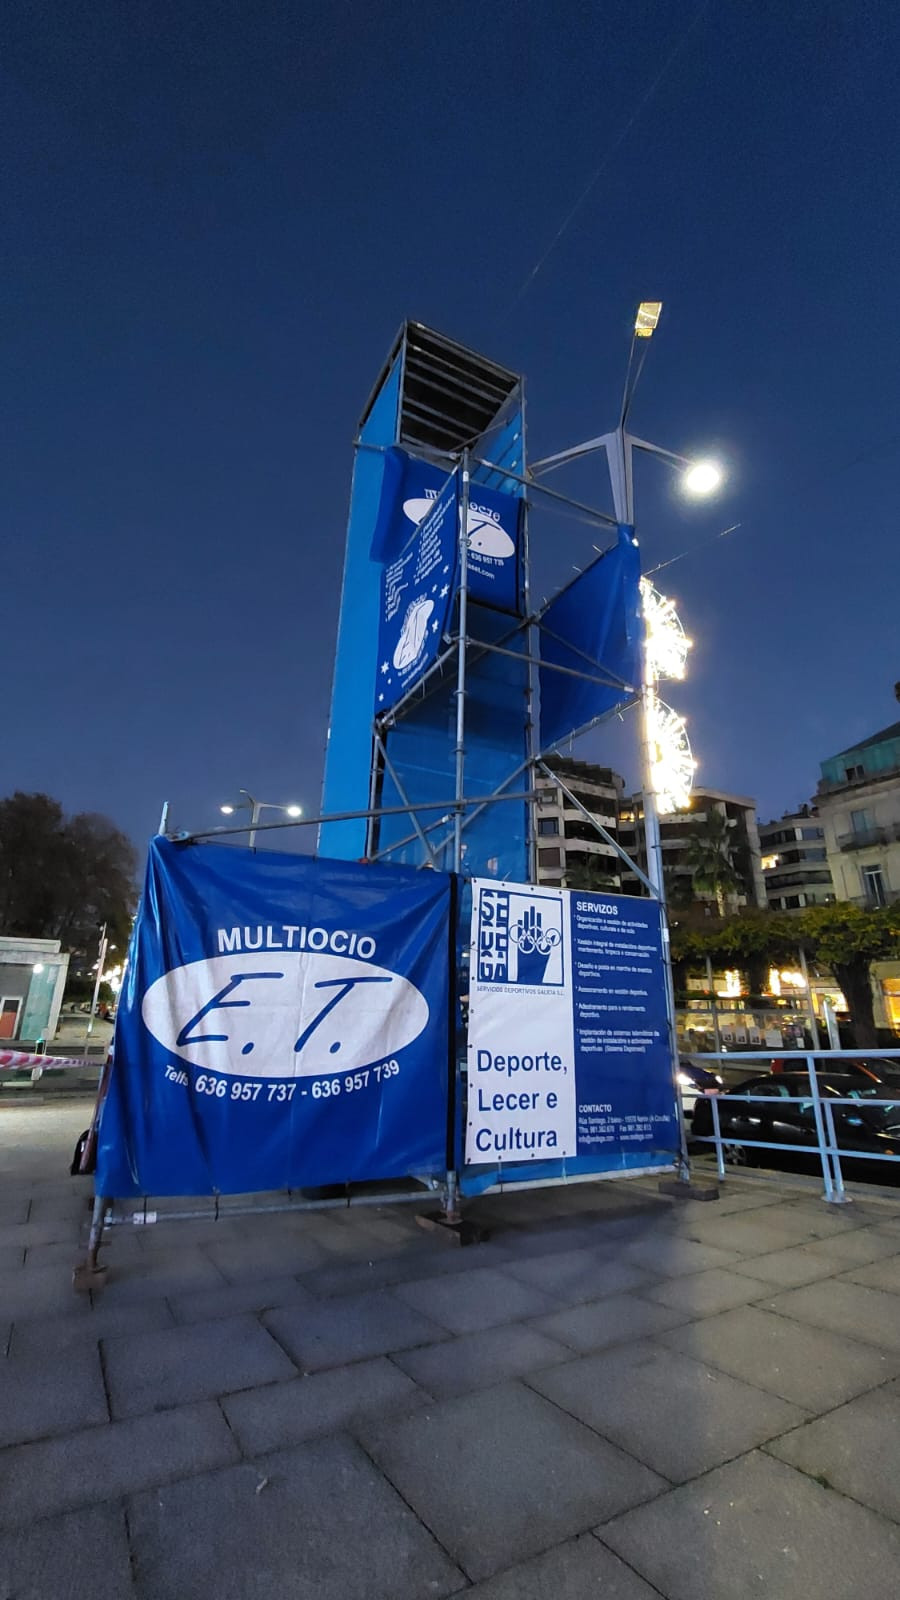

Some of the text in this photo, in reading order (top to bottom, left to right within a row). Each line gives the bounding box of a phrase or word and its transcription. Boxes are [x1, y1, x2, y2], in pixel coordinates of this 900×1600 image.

[576, 901, 618, 915] SERVIZOS
[218, 925, 376, 959] MULTIOCIO
[477, 1050, 567, 1077] Deporte,
[195, 1074, 227, 1098] 636
[230, 1083, 262, 1101] 957
[267, 1084, 296, 1101] 737
[311, 1079, 340, 1099] 636
[345, 1074, 369, 1093] 957
[373, 1059, 400, 1084] 739
[478, 1089, 558, 1112] Lecer e
[578, 1104, 612, 1113] CONTACTO
[476, 1127, 557, 1152] Cultura
